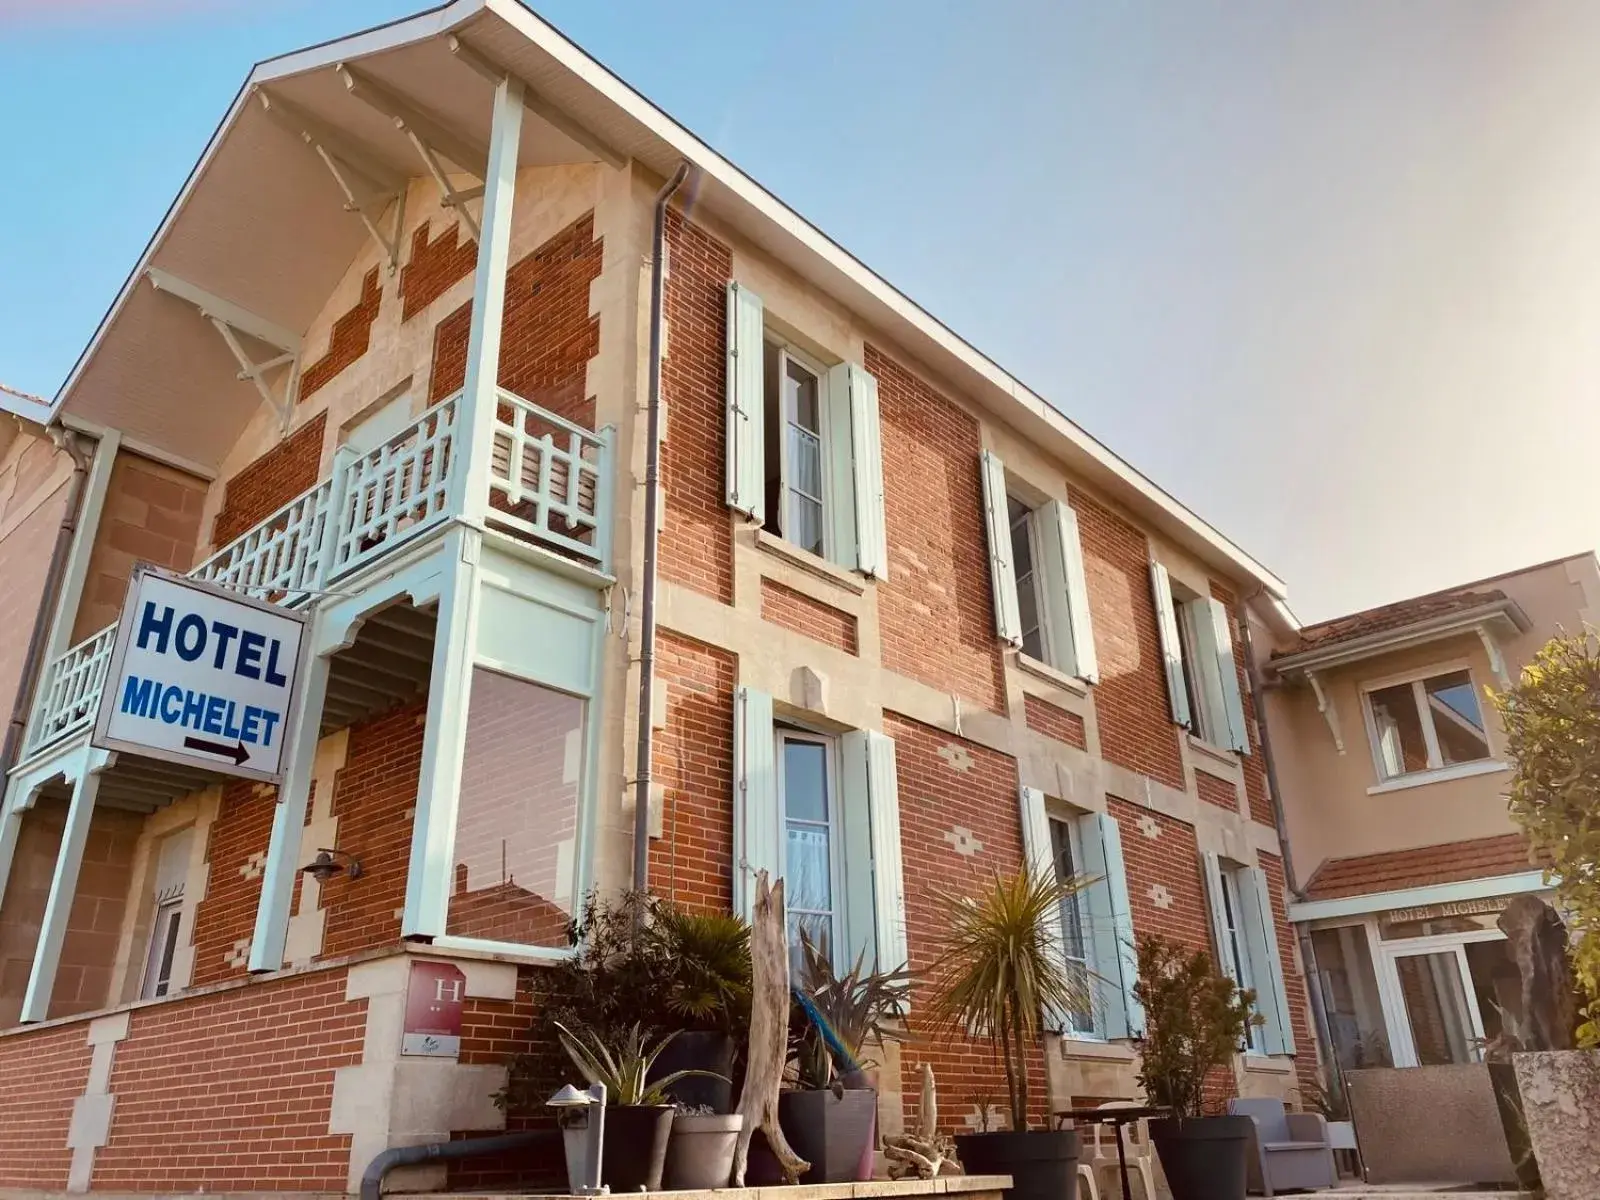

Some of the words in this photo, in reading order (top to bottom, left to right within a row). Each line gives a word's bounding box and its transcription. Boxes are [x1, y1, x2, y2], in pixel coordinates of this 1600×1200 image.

[136, 600, 287, 688] HOTEL
[120, 675, 280, 746] MICHELET
[1388, 906, 1434, 922] HOTEL
[434, 978, 462, 1003] H
